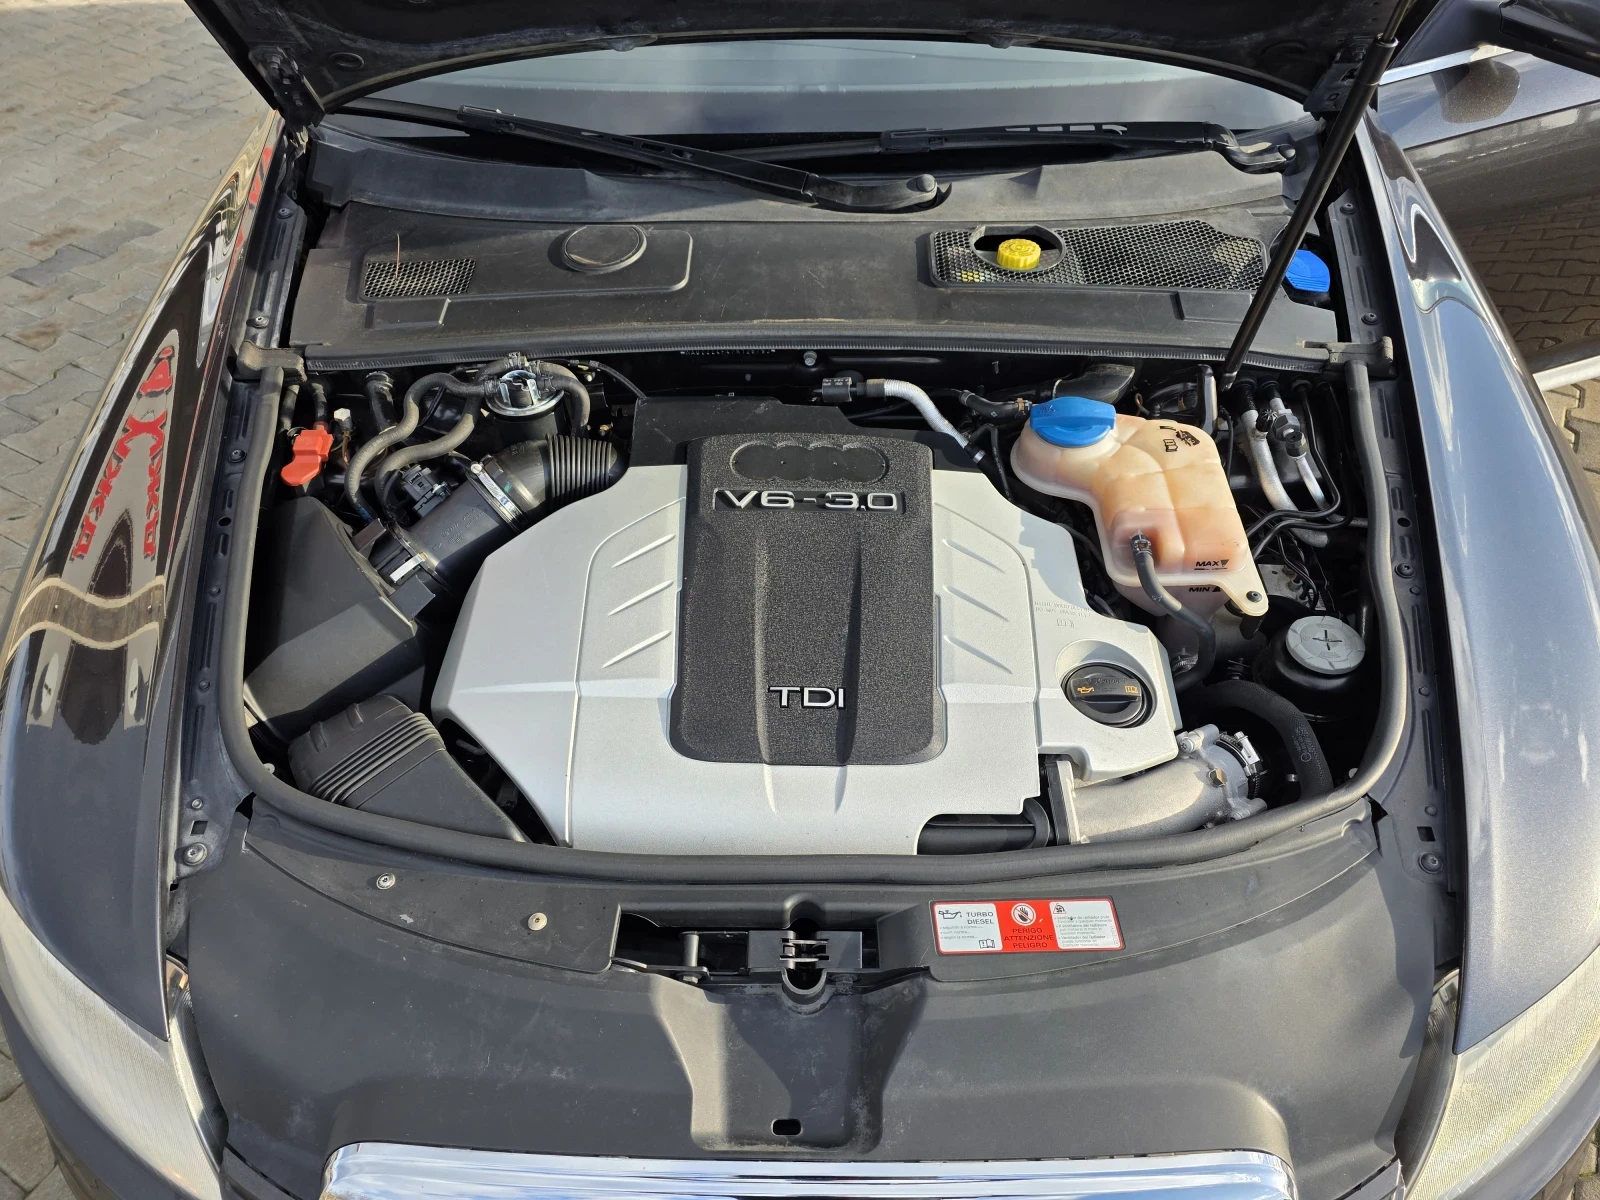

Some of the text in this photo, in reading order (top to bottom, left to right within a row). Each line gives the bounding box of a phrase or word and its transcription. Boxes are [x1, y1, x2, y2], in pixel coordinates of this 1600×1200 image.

[723, 490, 898, 512] V6-3.0
[768, 685, 846, 709] TDI
[1003, 934, 1054, 942] ATTENZIONE
[1013, 941, 1048, 949] PELIGRO
